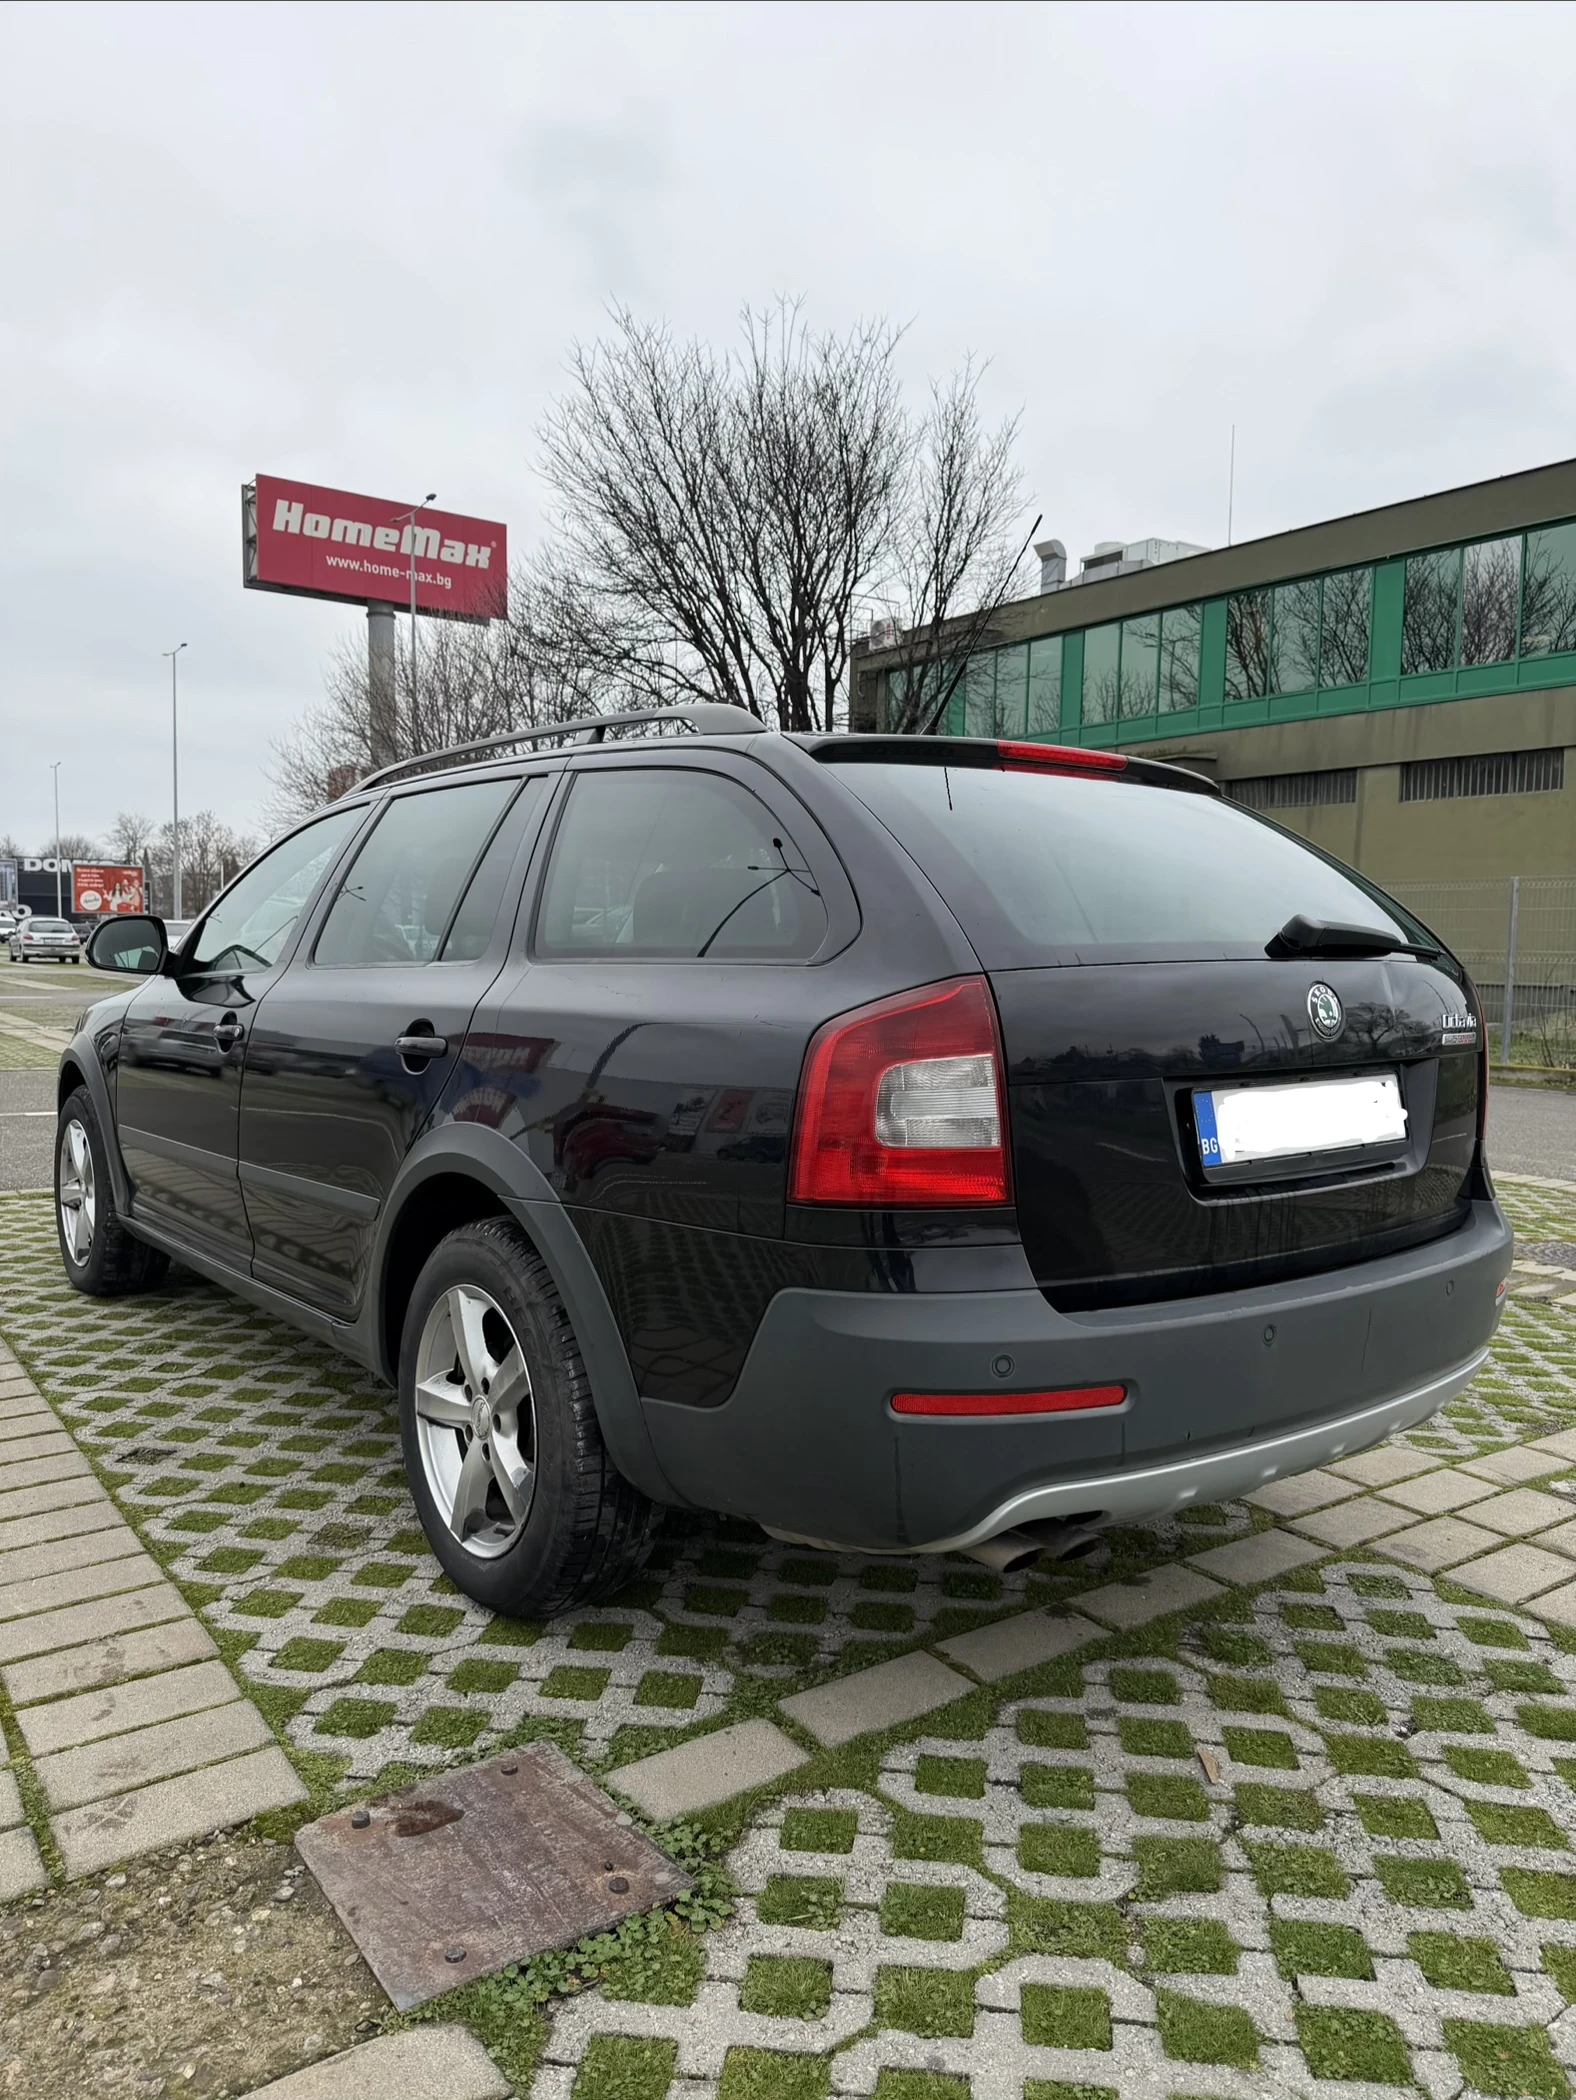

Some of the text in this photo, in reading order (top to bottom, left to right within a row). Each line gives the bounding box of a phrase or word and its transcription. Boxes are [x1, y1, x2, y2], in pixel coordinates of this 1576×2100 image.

[272, 498, 492, 570] HomeMax
[326, 554, 452, 590] www.home-max.bg
[1201, 1137, 1219, 1155] BG
